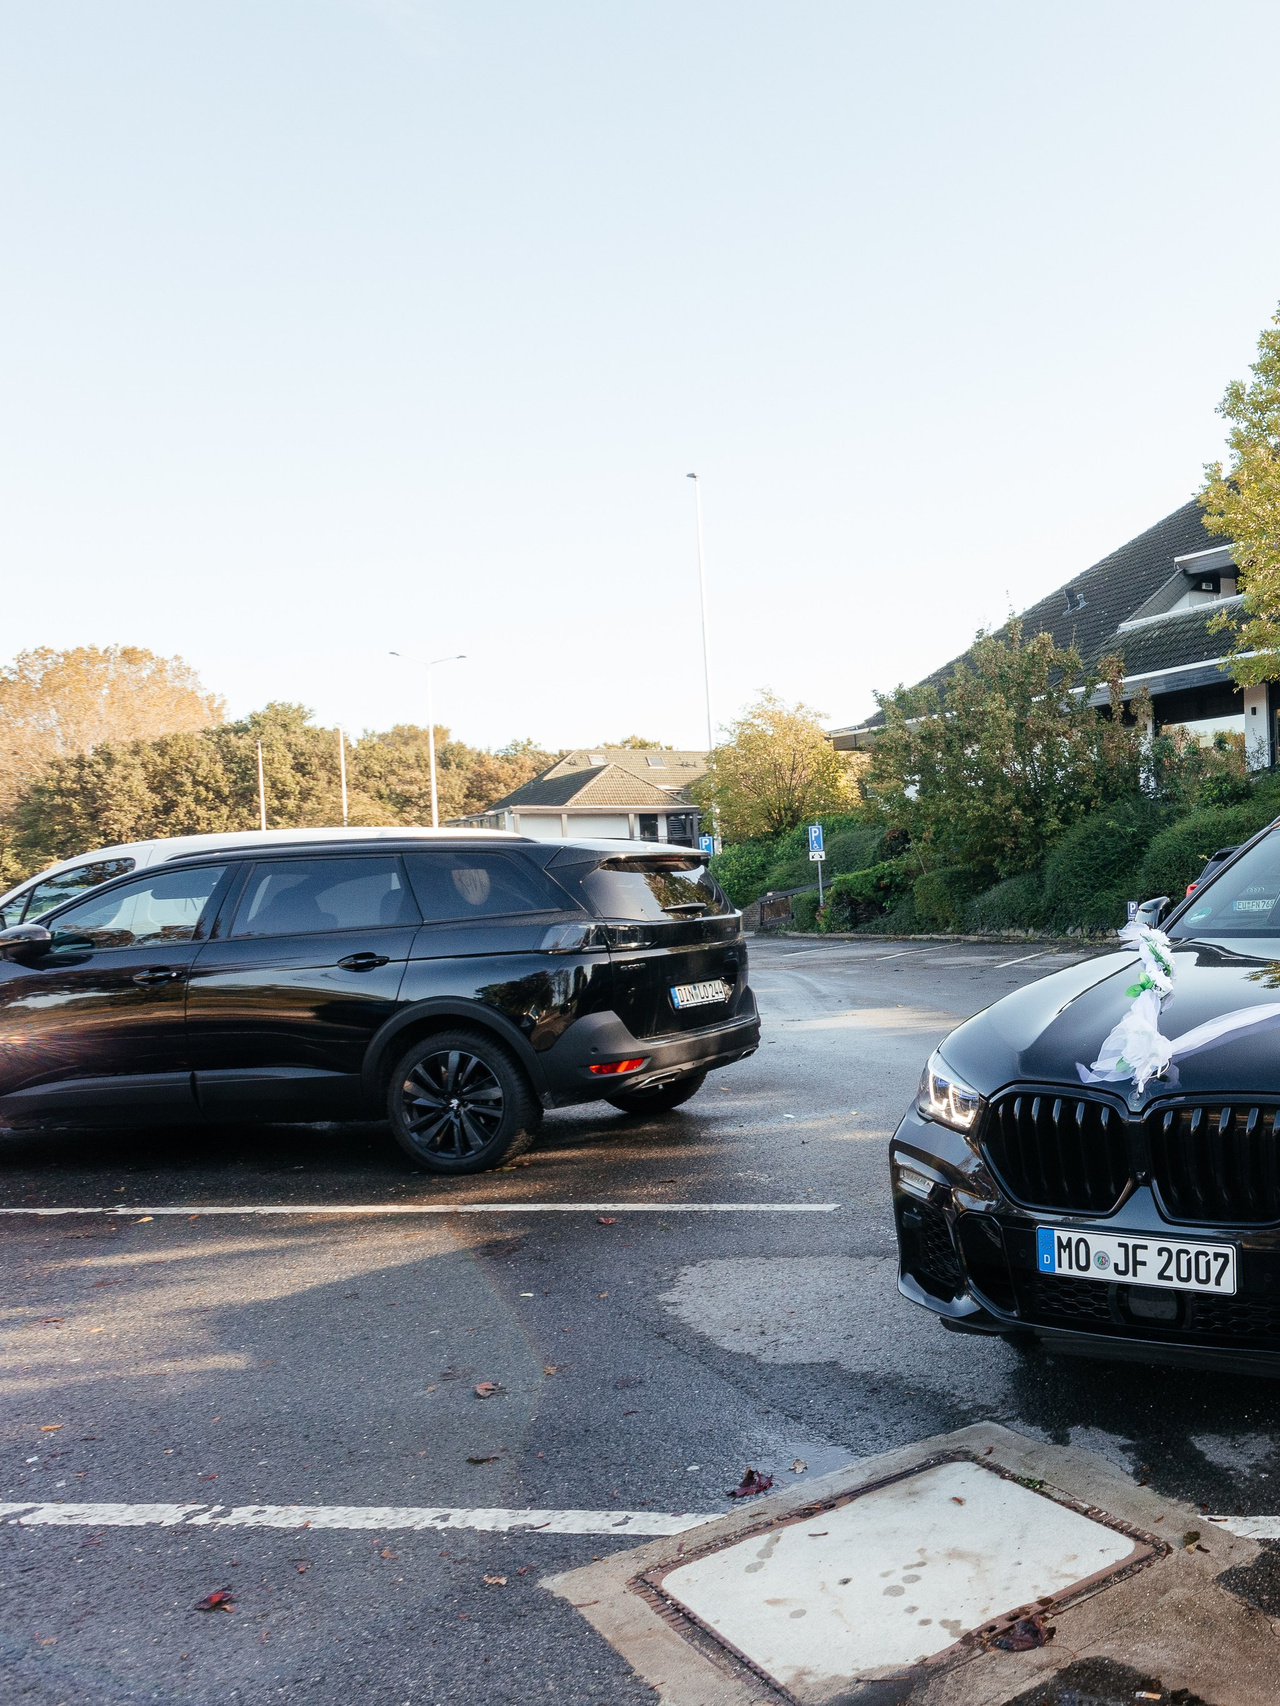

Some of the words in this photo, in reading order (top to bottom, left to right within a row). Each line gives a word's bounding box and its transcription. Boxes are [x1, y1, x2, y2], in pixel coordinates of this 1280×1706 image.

[811, 828, 819, 840] P
[702, 838, 710, 849] P
[677, 986, 696, 1003] DIN
[709, 982, 724, 998] 244
[1043, 1254, 1050, 1264] D
[1056, 1235, 1091, 1272] MO
[1113, 1242, 1149, 1278] JF
[1157, 1246, 1230, 1287] 2007
